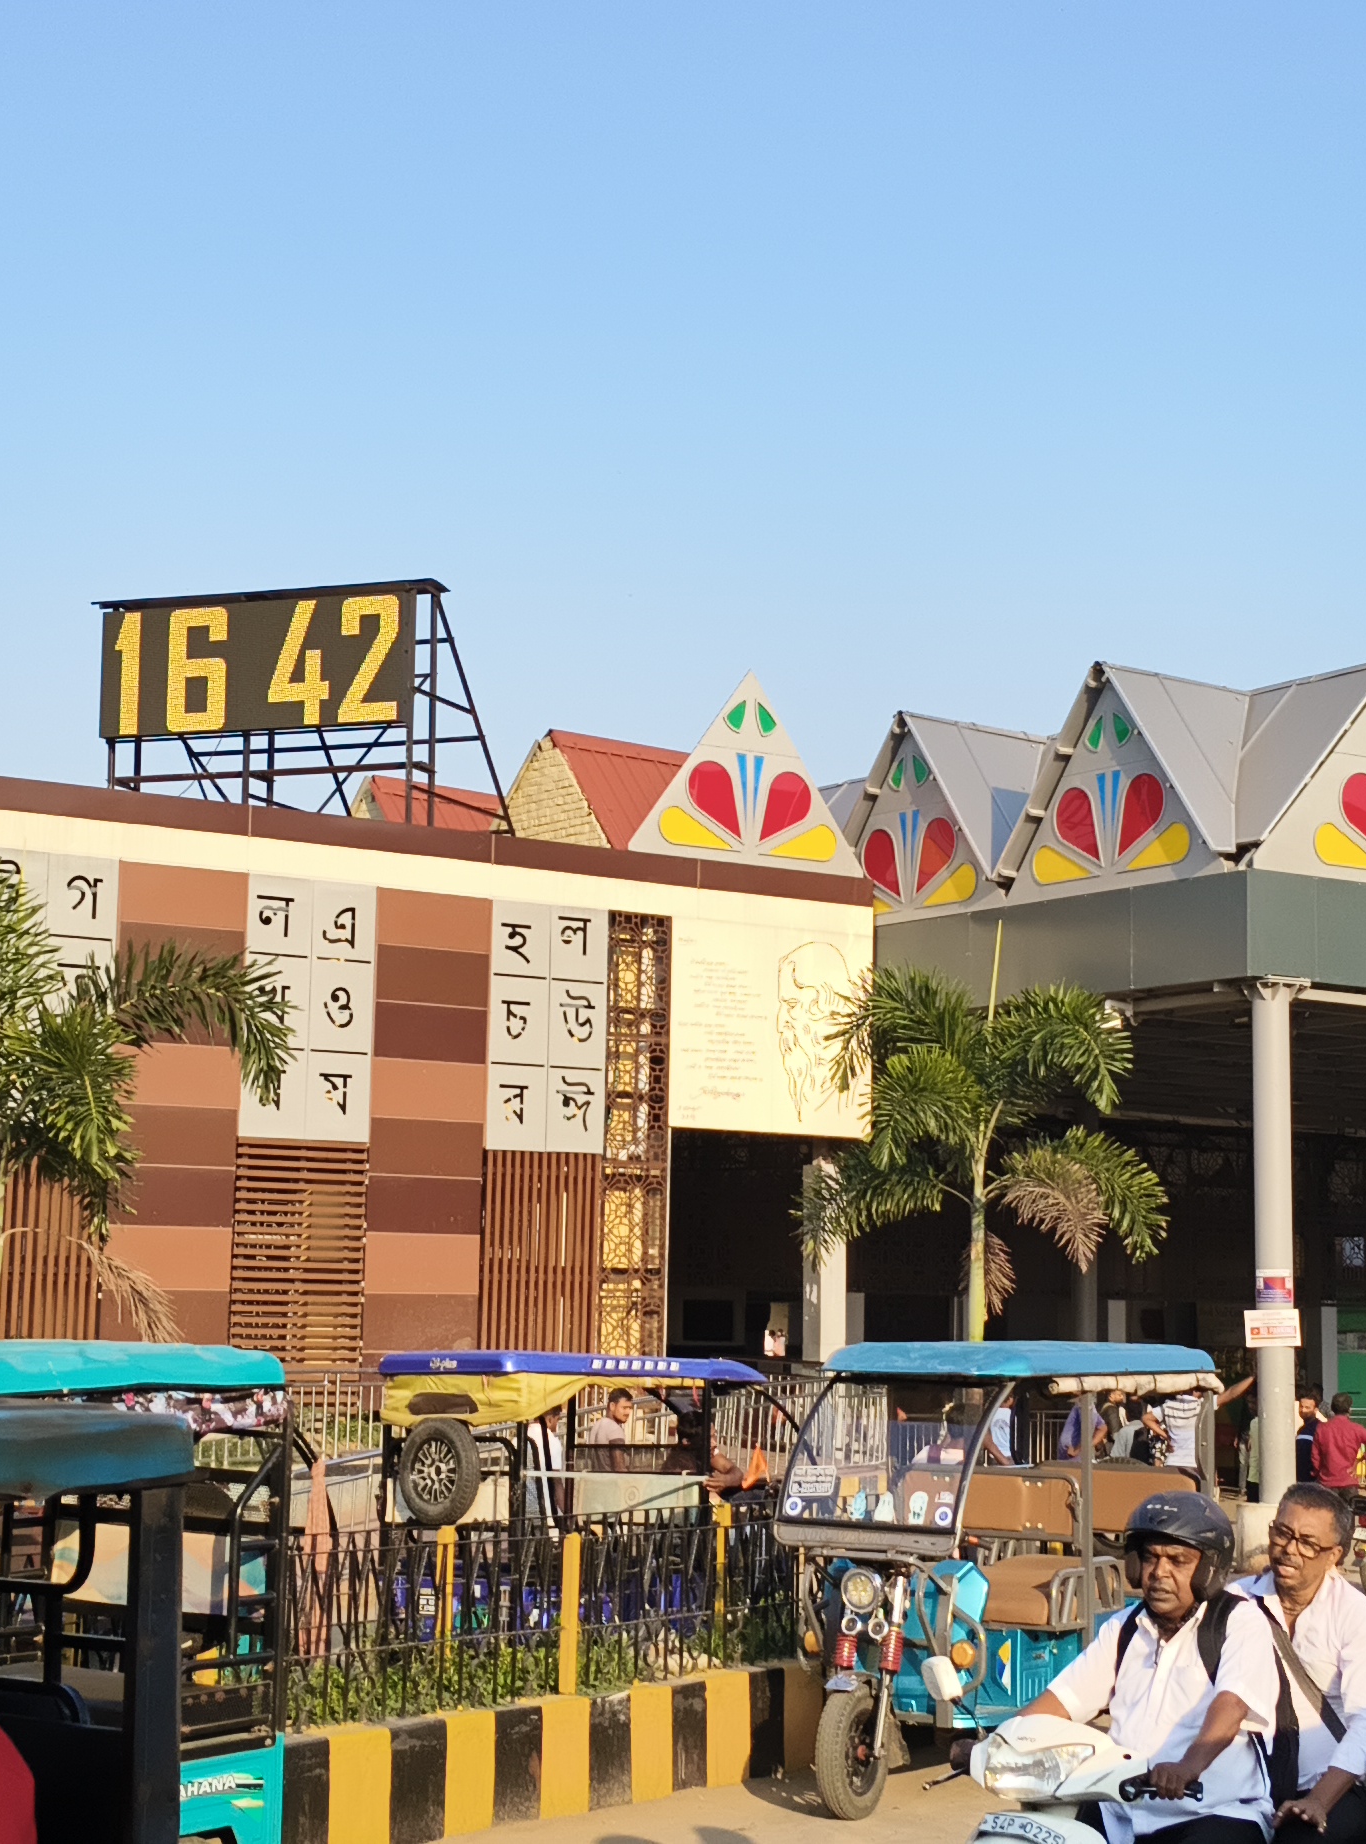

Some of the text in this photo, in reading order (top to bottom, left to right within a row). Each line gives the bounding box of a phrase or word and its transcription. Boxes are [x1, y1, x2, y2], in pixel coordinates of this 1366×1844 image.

[115, 594, 400, 734] 16 42
[67, 875, 103, 919] গ
[257, 894, 356, 949] ল এ
[501, 915, 591, 964] হ ল
[323, 987, 354, 1028] ও
[559, 989, 596, 1043] উ
[556, 1075, 595, 1132] ঈ
